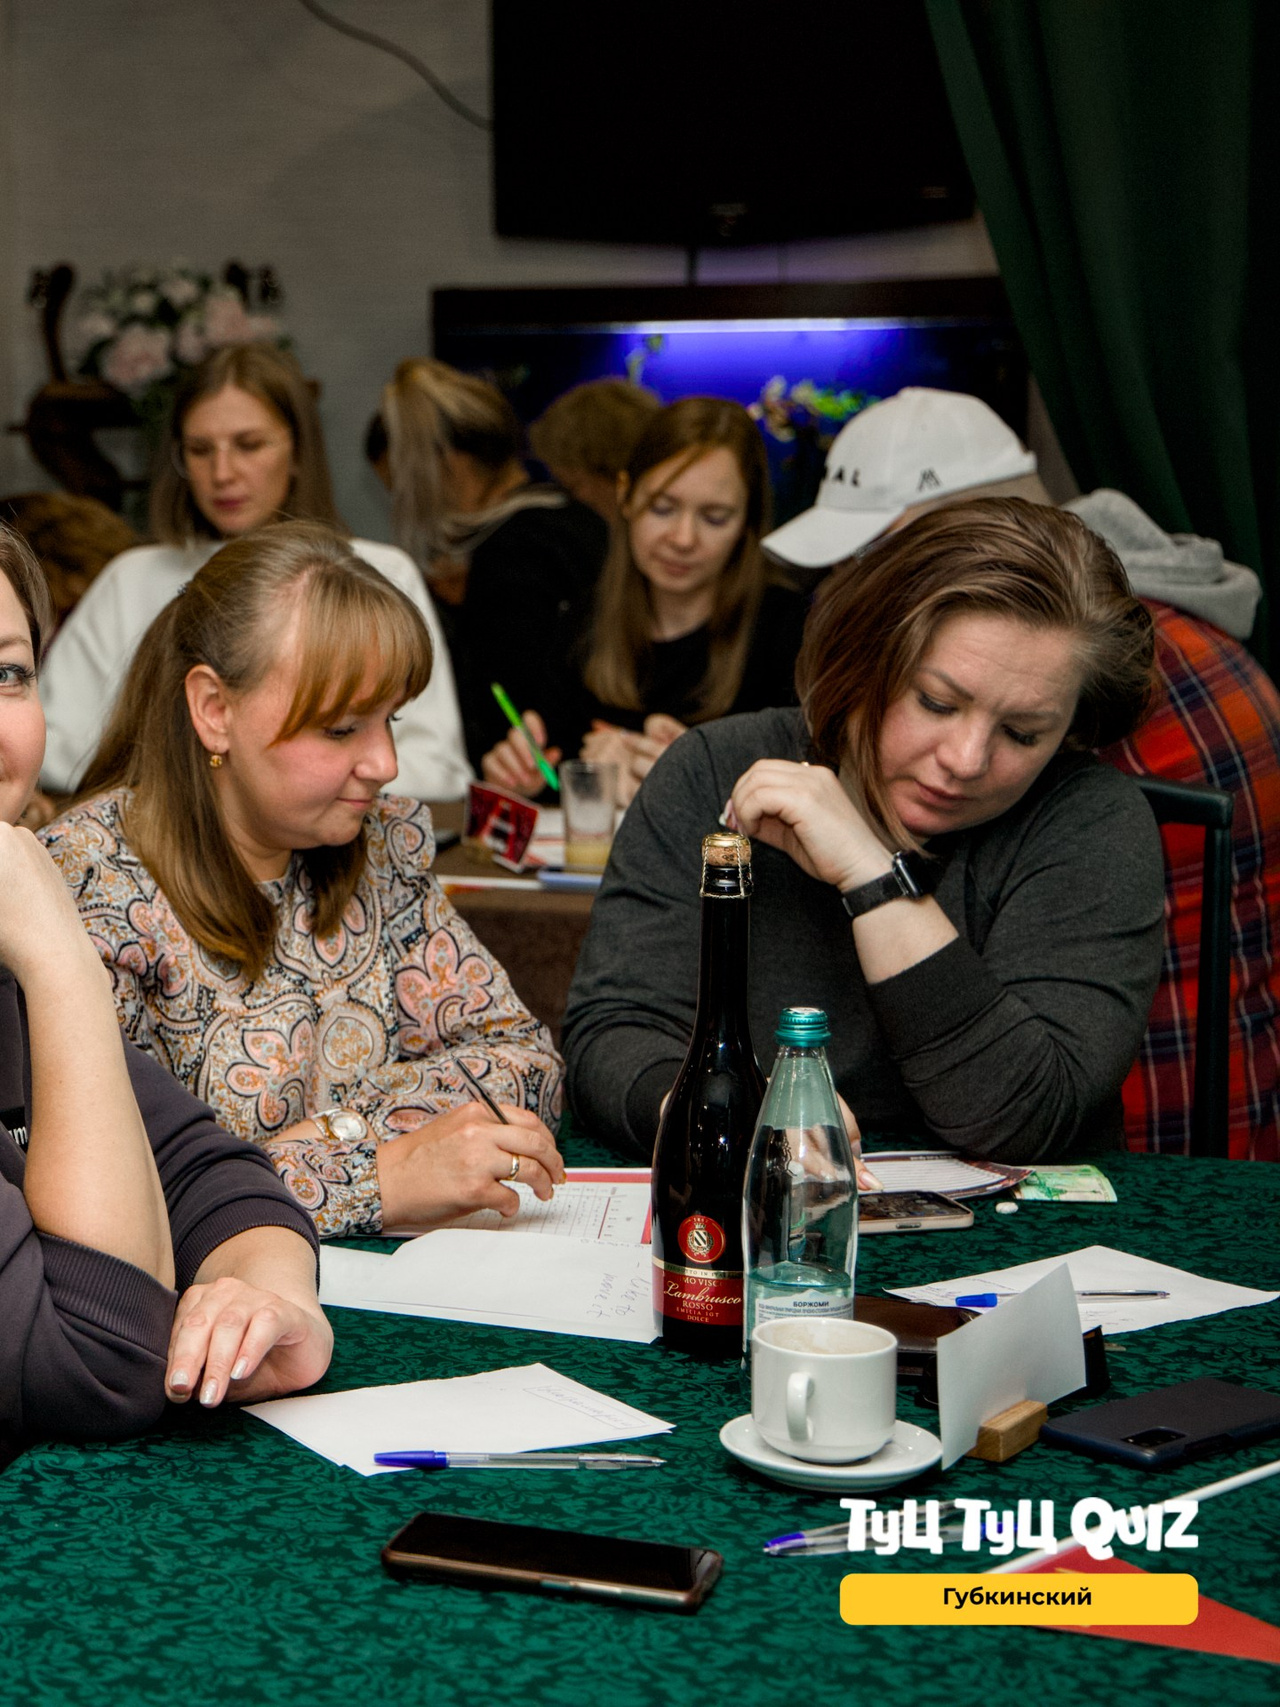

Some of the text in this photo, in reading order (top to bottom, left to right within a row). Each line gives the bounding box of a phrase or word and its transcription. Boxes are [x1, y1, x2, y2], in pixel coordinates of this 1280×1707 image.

[664, 1280, 742, 1304] Lambrusco
[682, 1300, 714, 1311] ROSSO
[687, 1314, 709, 1323] DOLCE
